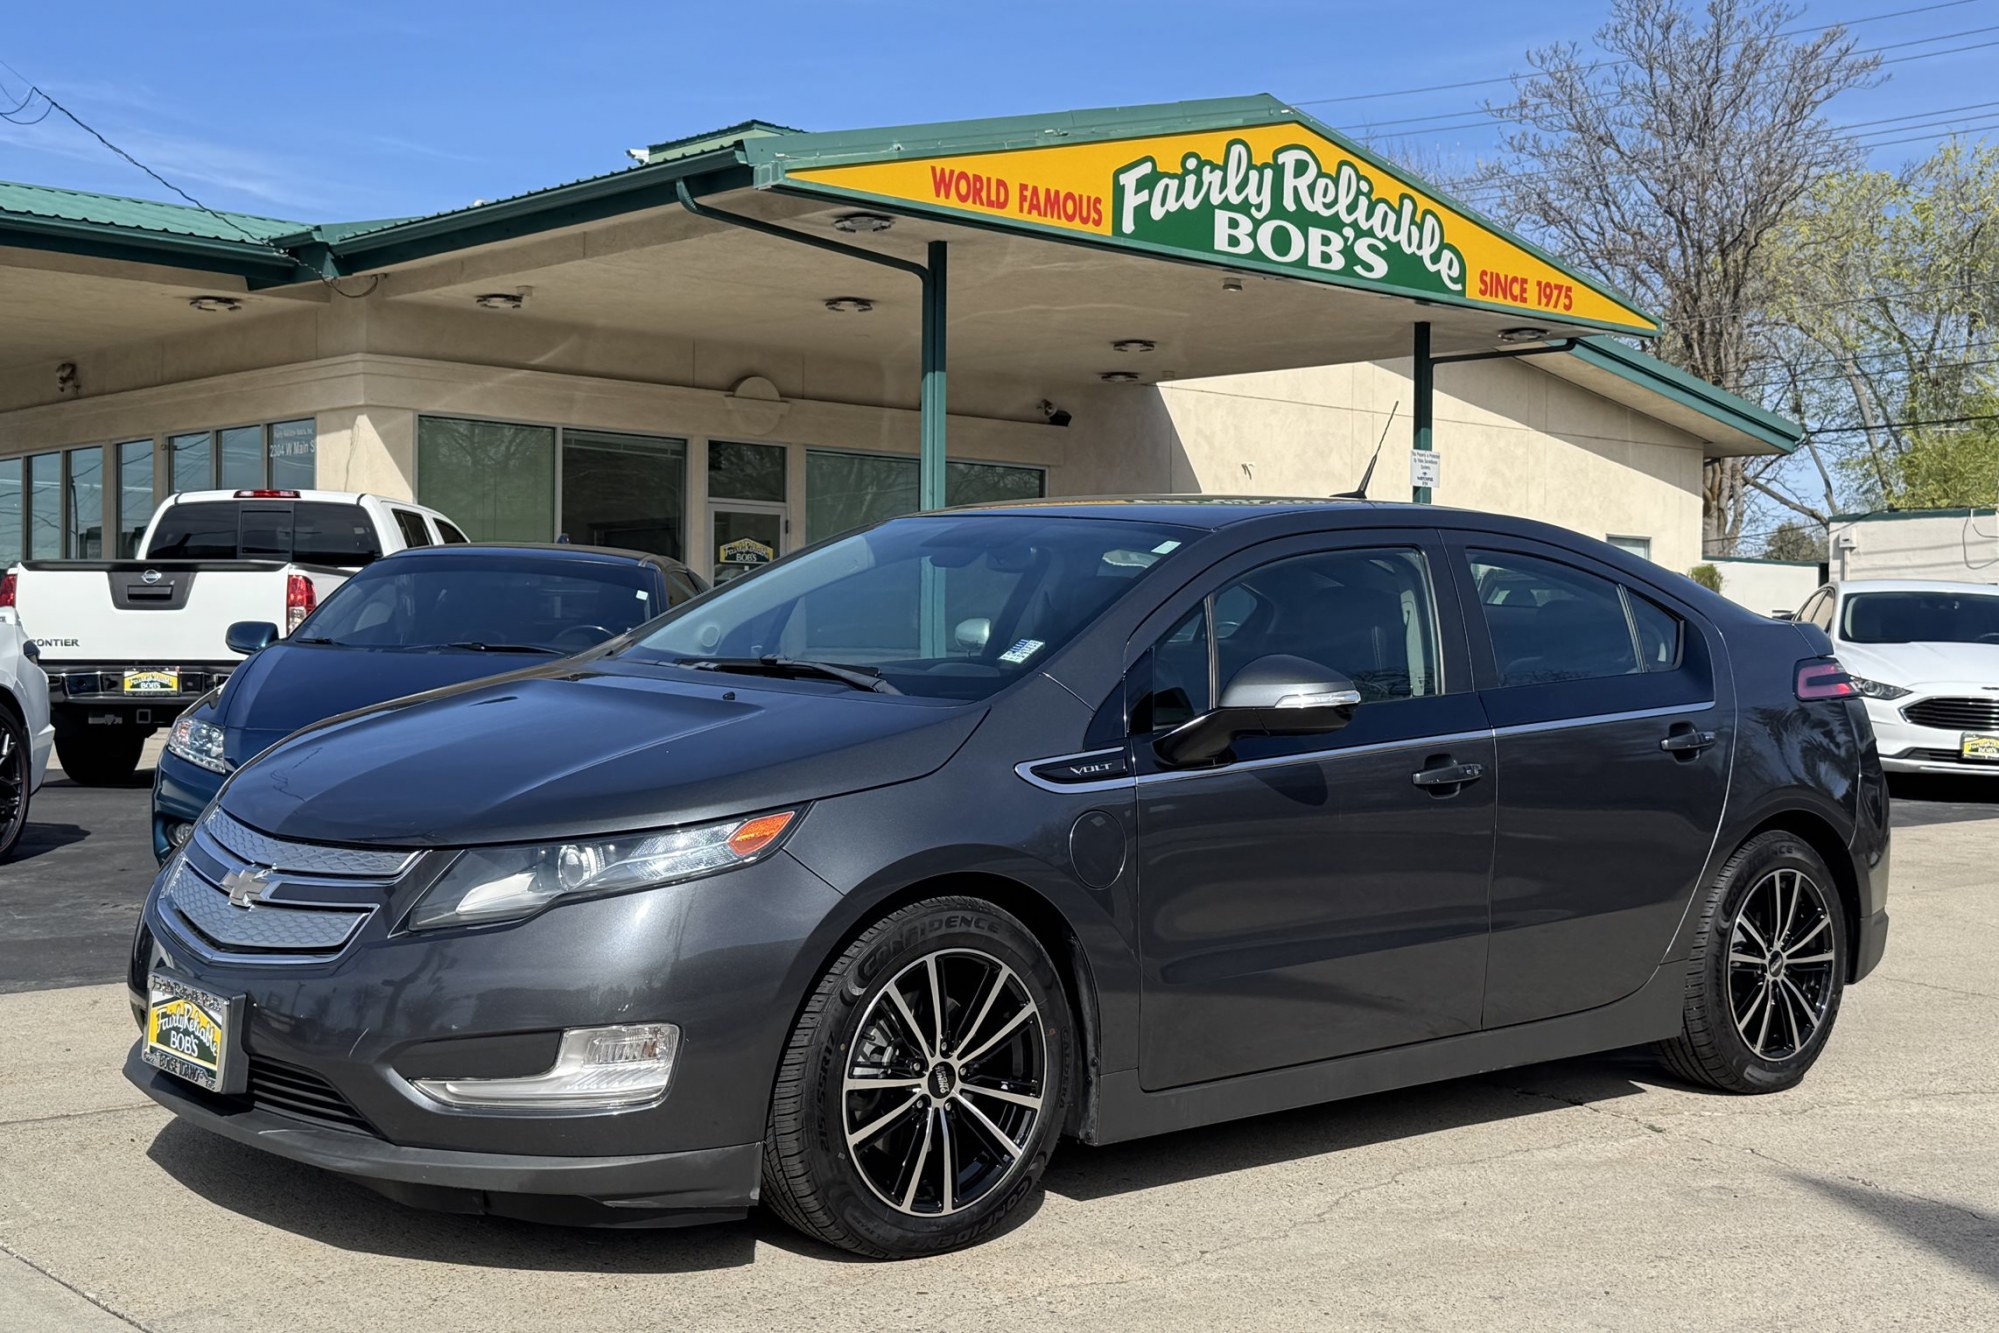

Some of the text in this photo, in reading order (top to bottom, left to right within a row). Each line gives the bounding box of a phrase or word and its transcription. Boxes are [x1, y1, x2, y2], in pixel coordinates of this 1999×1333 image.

[930, 165, 1103, 227] WORLD FAMOUS
[1119, 143, 1464, 291] Fairly Reliable
[1214, 208, 1389, 279] BOB'S
[1479, 269, 1573, 311] SINCE 1975
[285, 442, 293, 456] W
[293, 441, 309, 455] Main
[736, 553, 757, 562] BOB'S
[30, 639, 80, 647] ONTIER
[1070, 762, 1112, 775] VOLT
[156, 1003, 218, 1057] Fairly Reliable
[170, 1030, 199, 1057] BOB'S
